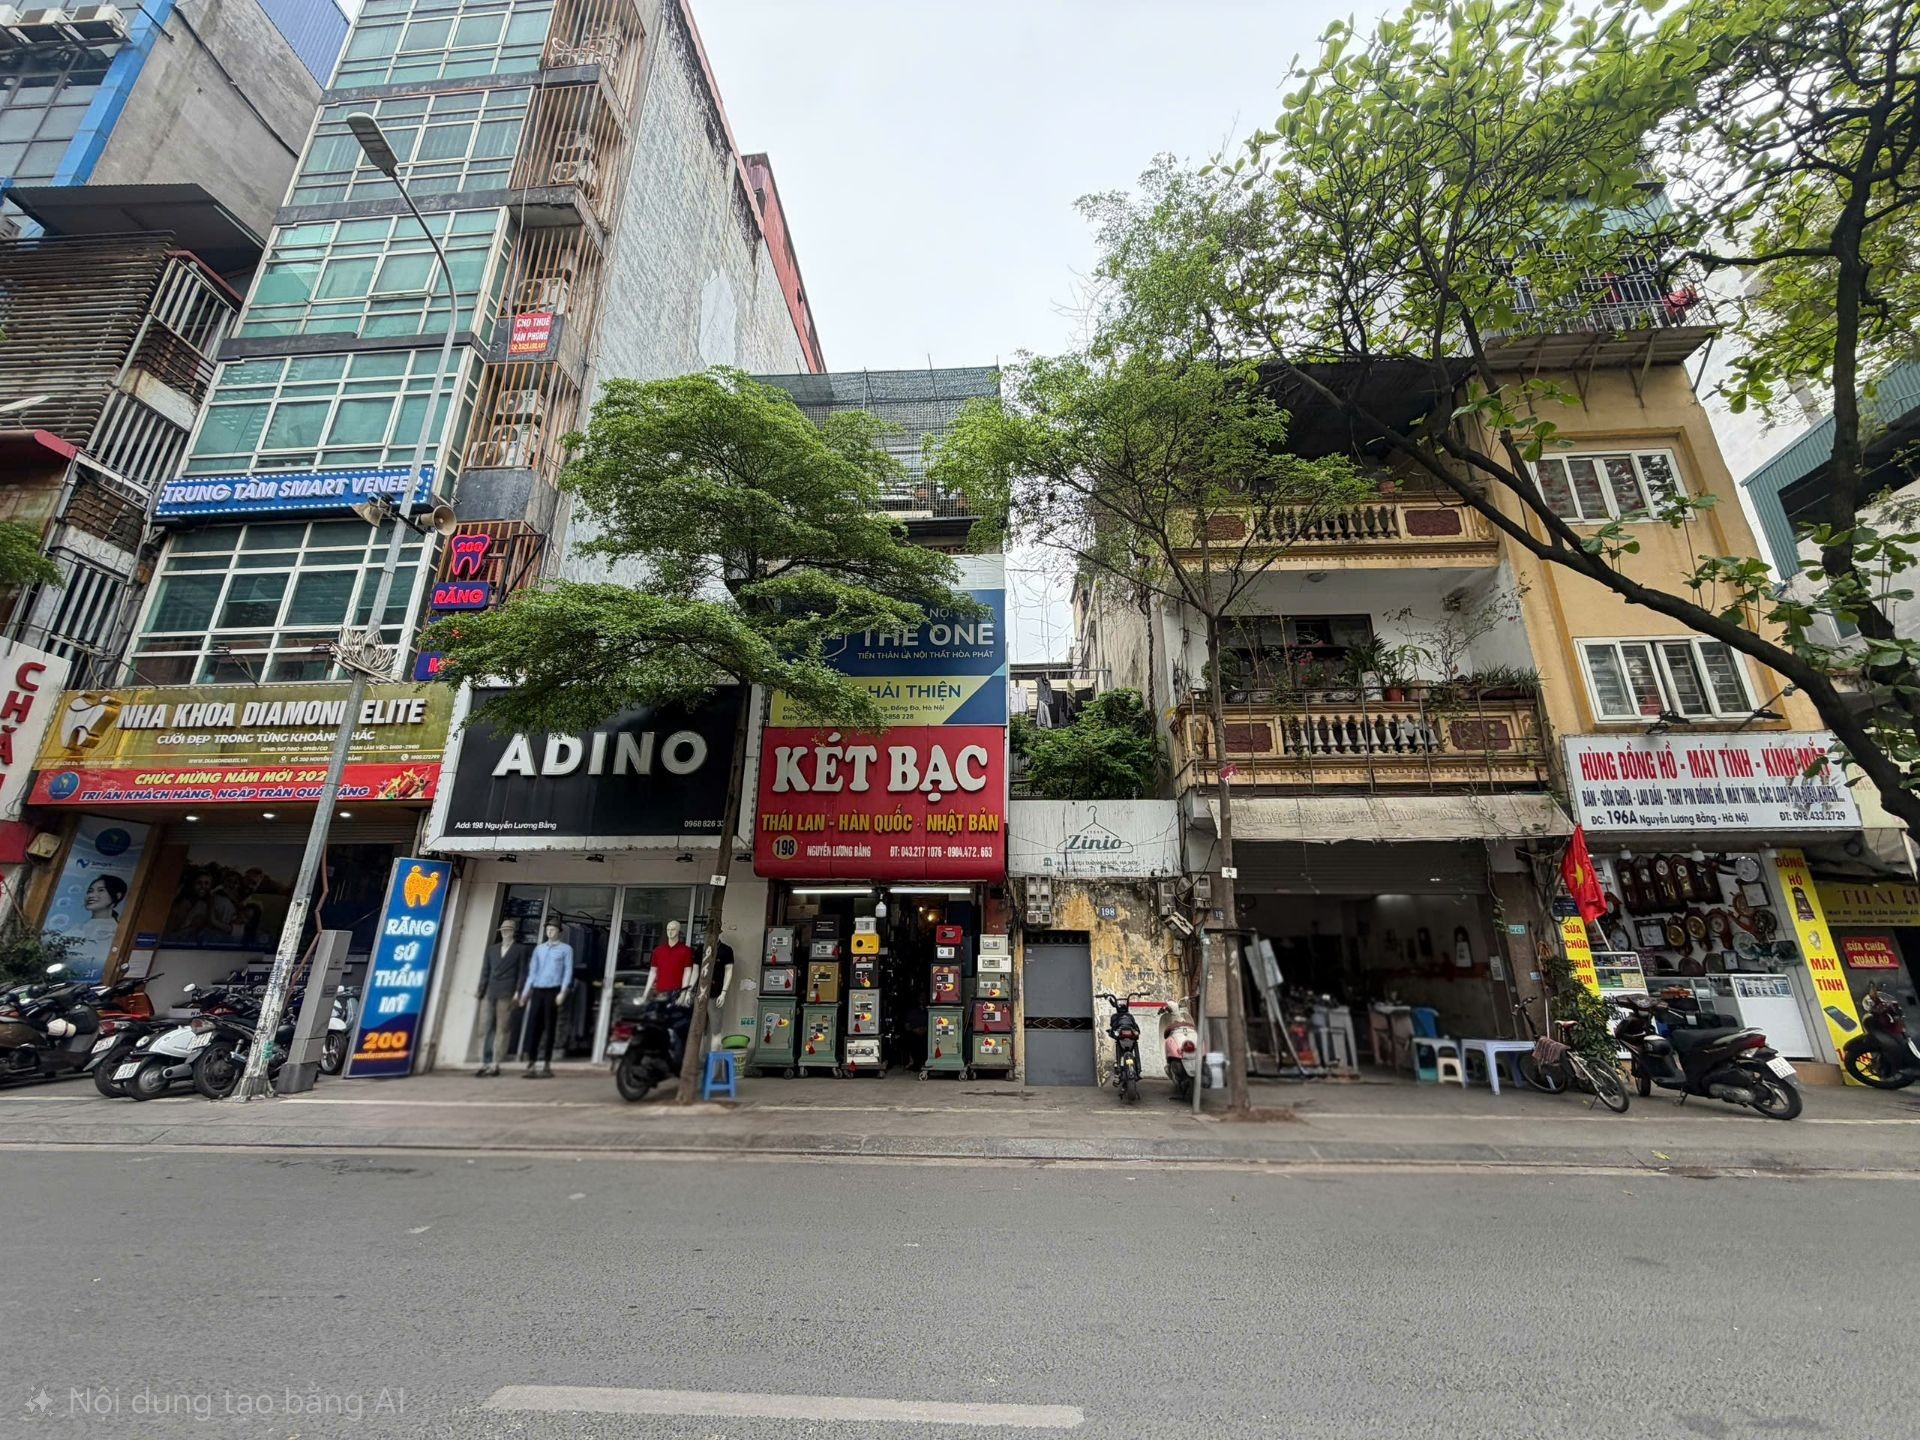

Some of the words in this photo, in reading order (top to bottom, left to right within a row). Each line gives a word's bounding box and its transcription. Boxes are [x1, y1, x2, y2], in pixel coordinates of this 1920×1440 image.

[164, 482, 231, 504] TRUNG
[234, 476, 278, 499] TÂM
[279, 477, 349, 498] SMART
[434, 586, 484, 604] RĂNG
[929, 624, 994, 646] ONE
[858, 650, 876, 660] TIỀN
[877, 650, 900, 659] THÂN
[913, 650, 928, 660] NỘI
[929, 648, 951, 658] THẤT
[952, 650, 971, 658] HÒA
[972, 650, 994, 658] PHÁT
[906, 680, 962, 702] THIỆN
[116, 703, 169, 730] NHA
[172, 702, 237, 729] KHOA
[358, 698, 428, 725] ELITE
[157, 734, 184, 745] CƯỜI
[187, 734, 210, 746] ĐẸP
[214, 734, 254, 744] TRONG
[256, 731, 290, 742] TỪNG
[350, 728, 376, 740] HẮC
[491, 730, 708, 776] ADINO
[1578, 746, 1618, 780] HÙNG
[1617, 741, 1658, 780] ĐỒNG
[1656, 740, 1678, 780] HỒ
[1686, 743, 1718, 778] MÁY
[1718, 742, 1754, 778] TÍNH
[1761, 742, 1799, 777] KÍNH
[772, 732, 878, 794] KÉT
[886, 744, 988, 802] BẠC
[134, 772, 173, 785] CHÚC
[175, 771, 222, 784] MỪNG
[224, 770, 259, 784] NĂM
[261, 768, 292, 782] MỚI
[294, 770, 328, 782] 202
[80, 790, 102, 802] TRI
[102, 788, 124, 801] ÂN
[125, 788, 172, 800] KHÁCH
[172, 788, 213, 800] HÀNG,
[216, 788, 258, 800] NGẬP
[258, 787, 293, 798] TRÀN
[338, 786, 370, 798] ẶNG
[1581, 787, 1598, 807] BÁN
[1600, 784, 1615, 806] SỬA
[1614, 786, 1634, 806] CHỮA
[1636, 788, 1650, 806] LAU
[1666, 788, 1684, 806] THAY
[1683, 788, 1697, 805] PIN
[1696, 782, 1715, 804] ĐỒNG
[1726, 784, 1741, 804] MÁY
[1759, 782, 1774, 804] CÁC
[485, 820, 512, 830] Nguyễn
[514, 822, 538, 830] Lương
[762, 810, 794, 832] THÁI
[796, 815, 826, 832] LAN
[838, 810, 870, 832] HÀN
[874, 804, 912, 834] QUỐC
[926, 812, 966, 836] NHẬT
[968, 807, 999, 832] BẢN
[1591, 816, 1606, 825] ĐC:
[1606, 810, 1638, 825] 196A
[1639, 812, 1670, 826] Nguyễn
[1670, 814, 1696, 826] Lương
[1696, 810, 1718, 824] Bằng
[1722, 812, 1734, 822] Hà
[1736, 812, 1750, 824] Nội
[1780, 812, 1792, 822] ĐT:
[1793, 810, 1846, 821] 098.433.2729
[774, 839, 796, 857] 198
[807, 842, 832, 857] NGUYỄN
[832, 845, 852, 857] LƯƠNG
[854, 842, 872, 857] BẰNG
[1066, 834, 1122, 850] Zinio
[890, 846, 900, 857] ĐT:
[1775, 856, 1806, 868] ĐỒNG
[1788, 874, 1803, 886] HỒ
[1101, 908, 1116, 916] 198
[384, 916, 437, 936] RĂNG
[1564, 922, 1582, 934] SỬA
[393, 940, 420, 962] SỨ
[1565, 938, 1589, 949] CHỮA
[1810, 956, 1836, 971] MÁY
[374, 964, 427, 988] THẨM
[1816, 976, 1844, 992] TÍNH
[378, 992, 411, 1014] MỸ
[362, 1032, 408, 1050] 200
